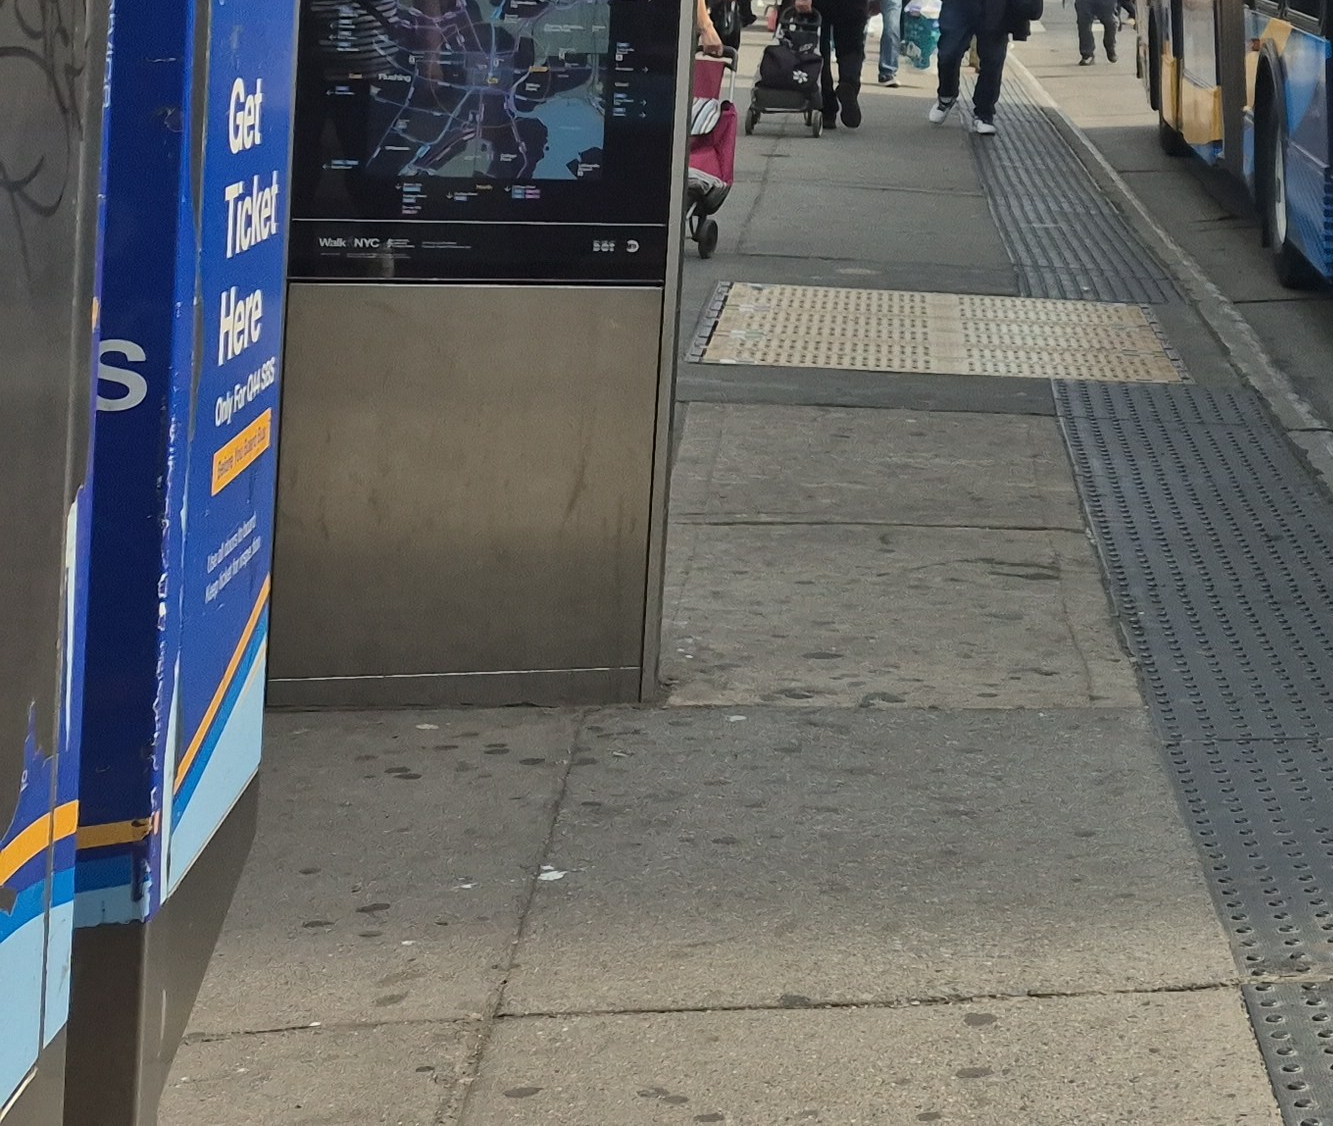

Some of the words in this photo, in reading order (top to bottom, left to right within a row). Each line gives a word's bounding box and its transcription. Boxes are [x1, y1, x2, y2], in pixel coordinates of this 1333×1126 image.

[228, 77, 263, 154] Get
[225, 170, 279, 260] Ticket
[319, 238, 346, 248] Walk
[354, 238, 380, 248] NYC
[218, 286, 262, 366] Here
[216, 391, 234, 426] Only
[234, 383, 247, 413] For
